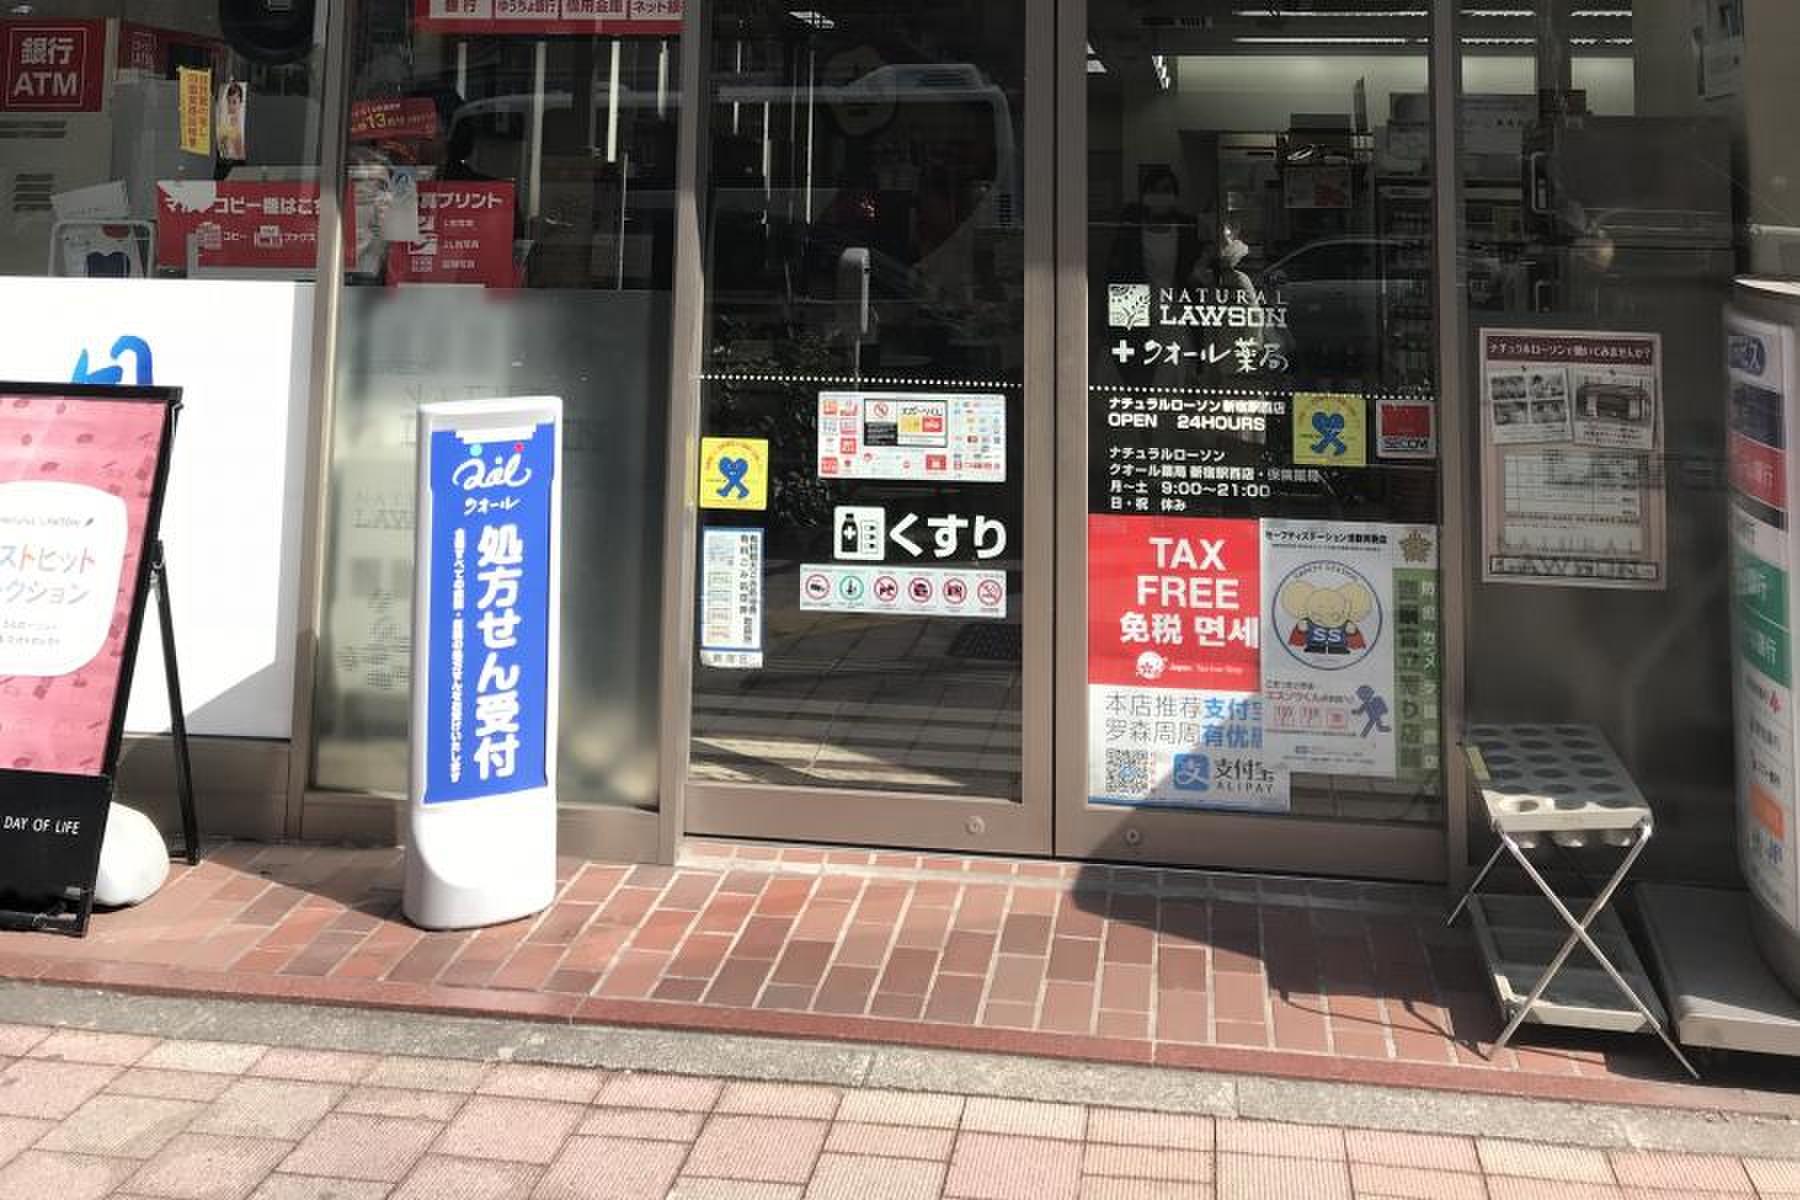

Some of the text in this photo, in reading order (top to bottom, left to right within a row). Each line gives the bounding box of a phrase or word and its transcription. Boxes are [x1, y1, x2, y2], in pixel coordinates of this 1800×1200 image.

[21, 37, 74, 65] 銀行
[13, 72, 79, 97] ATM
[1159, 287, 1288, 305] NATURAL
[1159, 304, 1288, 328] LAWSON
[1143, 337, 1290, 373] クオール薬局
[1107, 412, 1266, 432] OPEN 24HOURS
[1109, 447, 1226, 462] ナチュラルローソン
[463, 497, 520, 516] クオール
[1161, 498, 1188, 512] 休み
[889, 512, 1007, 560] くすり
[1148, 537, 1227, 572] TAX
[1136, 575, 1241, 609] FREE
[1119, 611, 1259, 649] 免税 면세
[473, 523, 524, 781] 処方せん受付
[1216, 783, 1274, 794] ALIPAY
[3, 815, 80, 835] DAY OF LIFE
